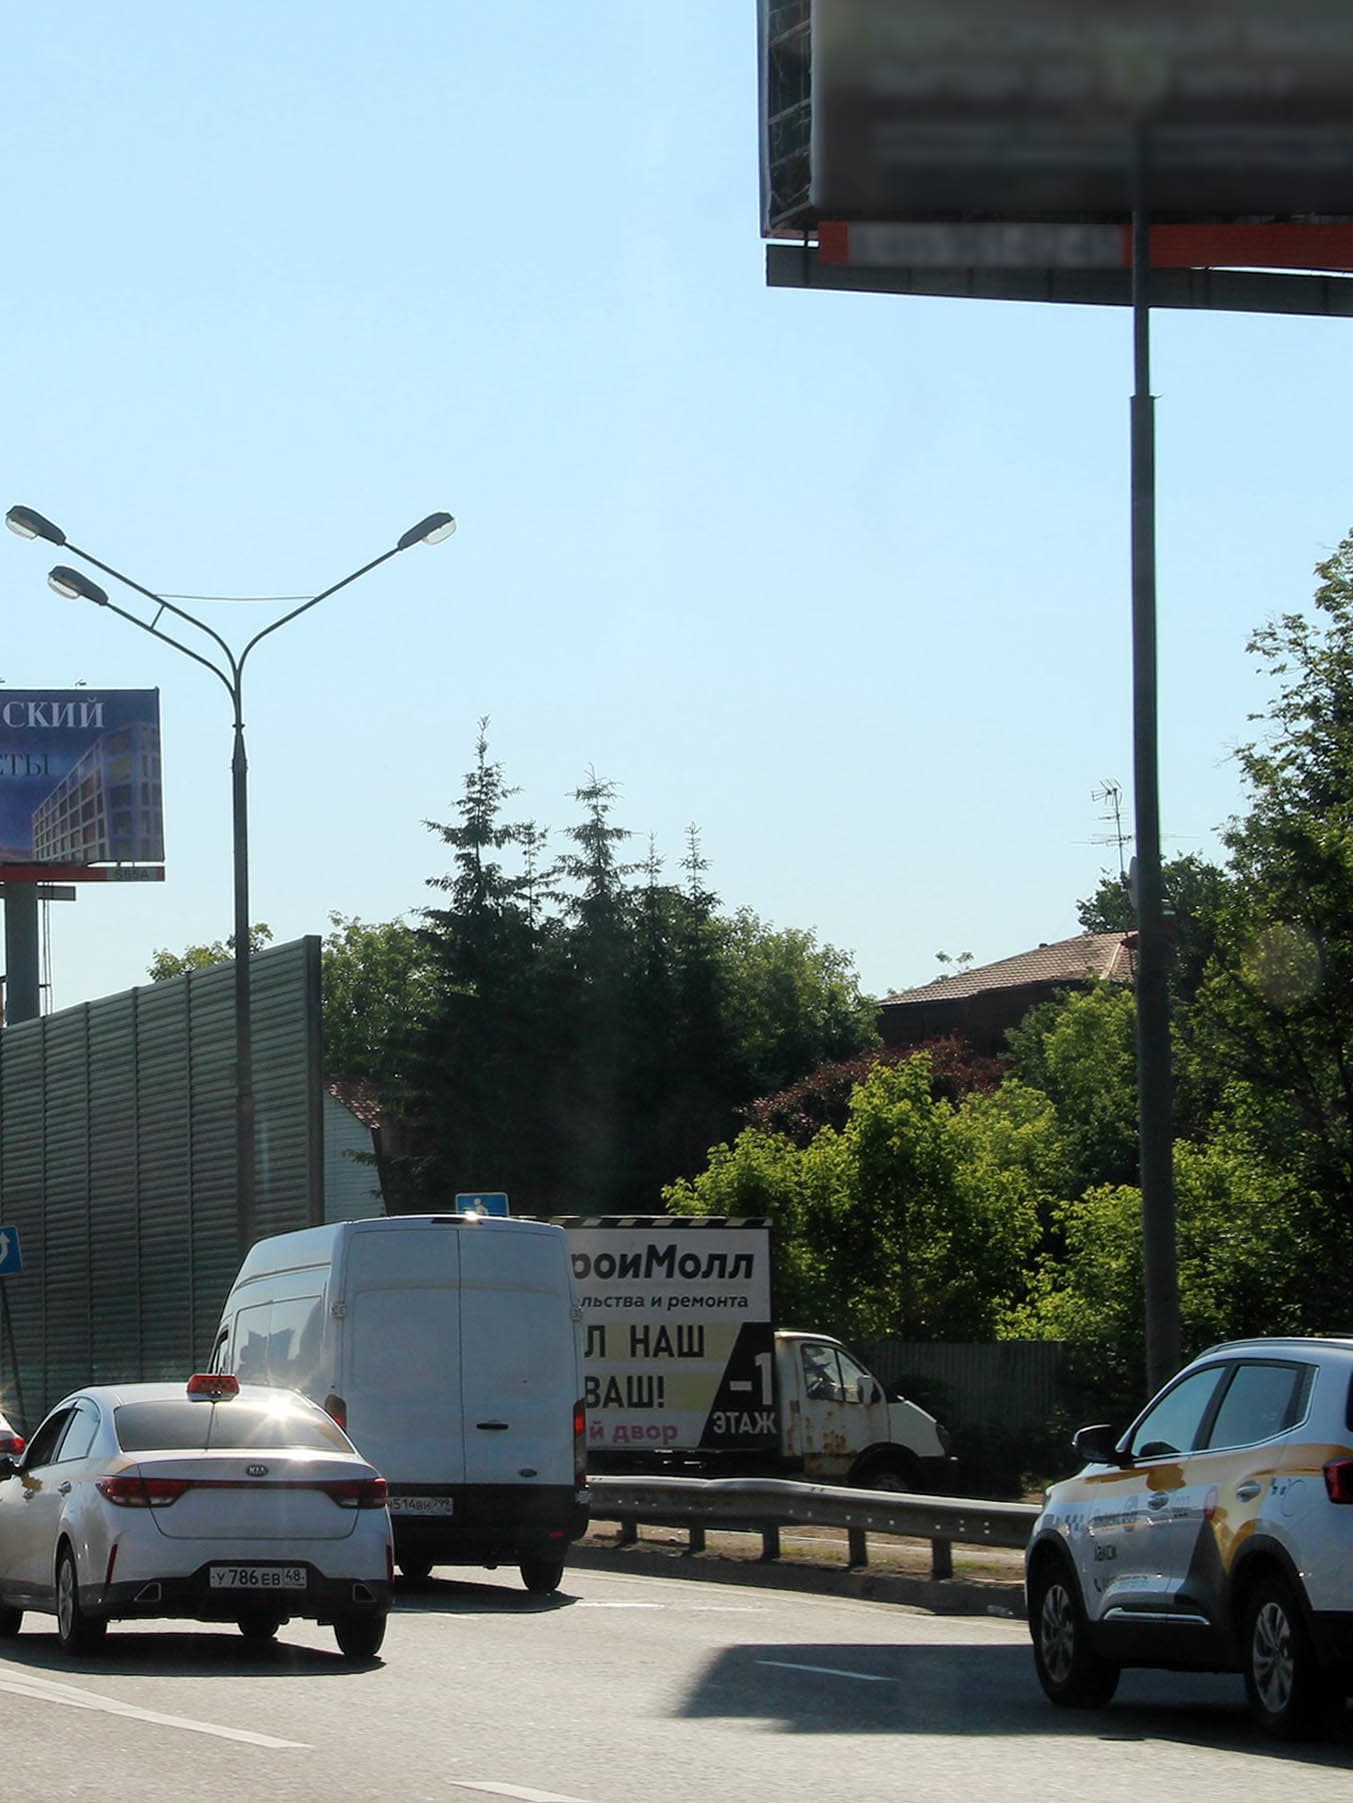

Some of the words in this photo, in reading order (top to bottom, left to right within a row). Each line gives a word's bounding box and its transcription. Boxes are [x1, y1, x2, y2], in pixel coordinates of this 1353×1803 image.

[651, 1296, 662, 1308] и
[667, 1295, 749, 1311] ремонта
[584, 1325, 606, 1358] Л
[630, 1325, 704, 1358] НАШ
[584, 1375, 665, 1409] ВАШ!
[729, 1352, 773, 1406] -1
[613, 1424, 679, 1445] двор
[712, 1411, 777, 1435] ЭТАЖ
